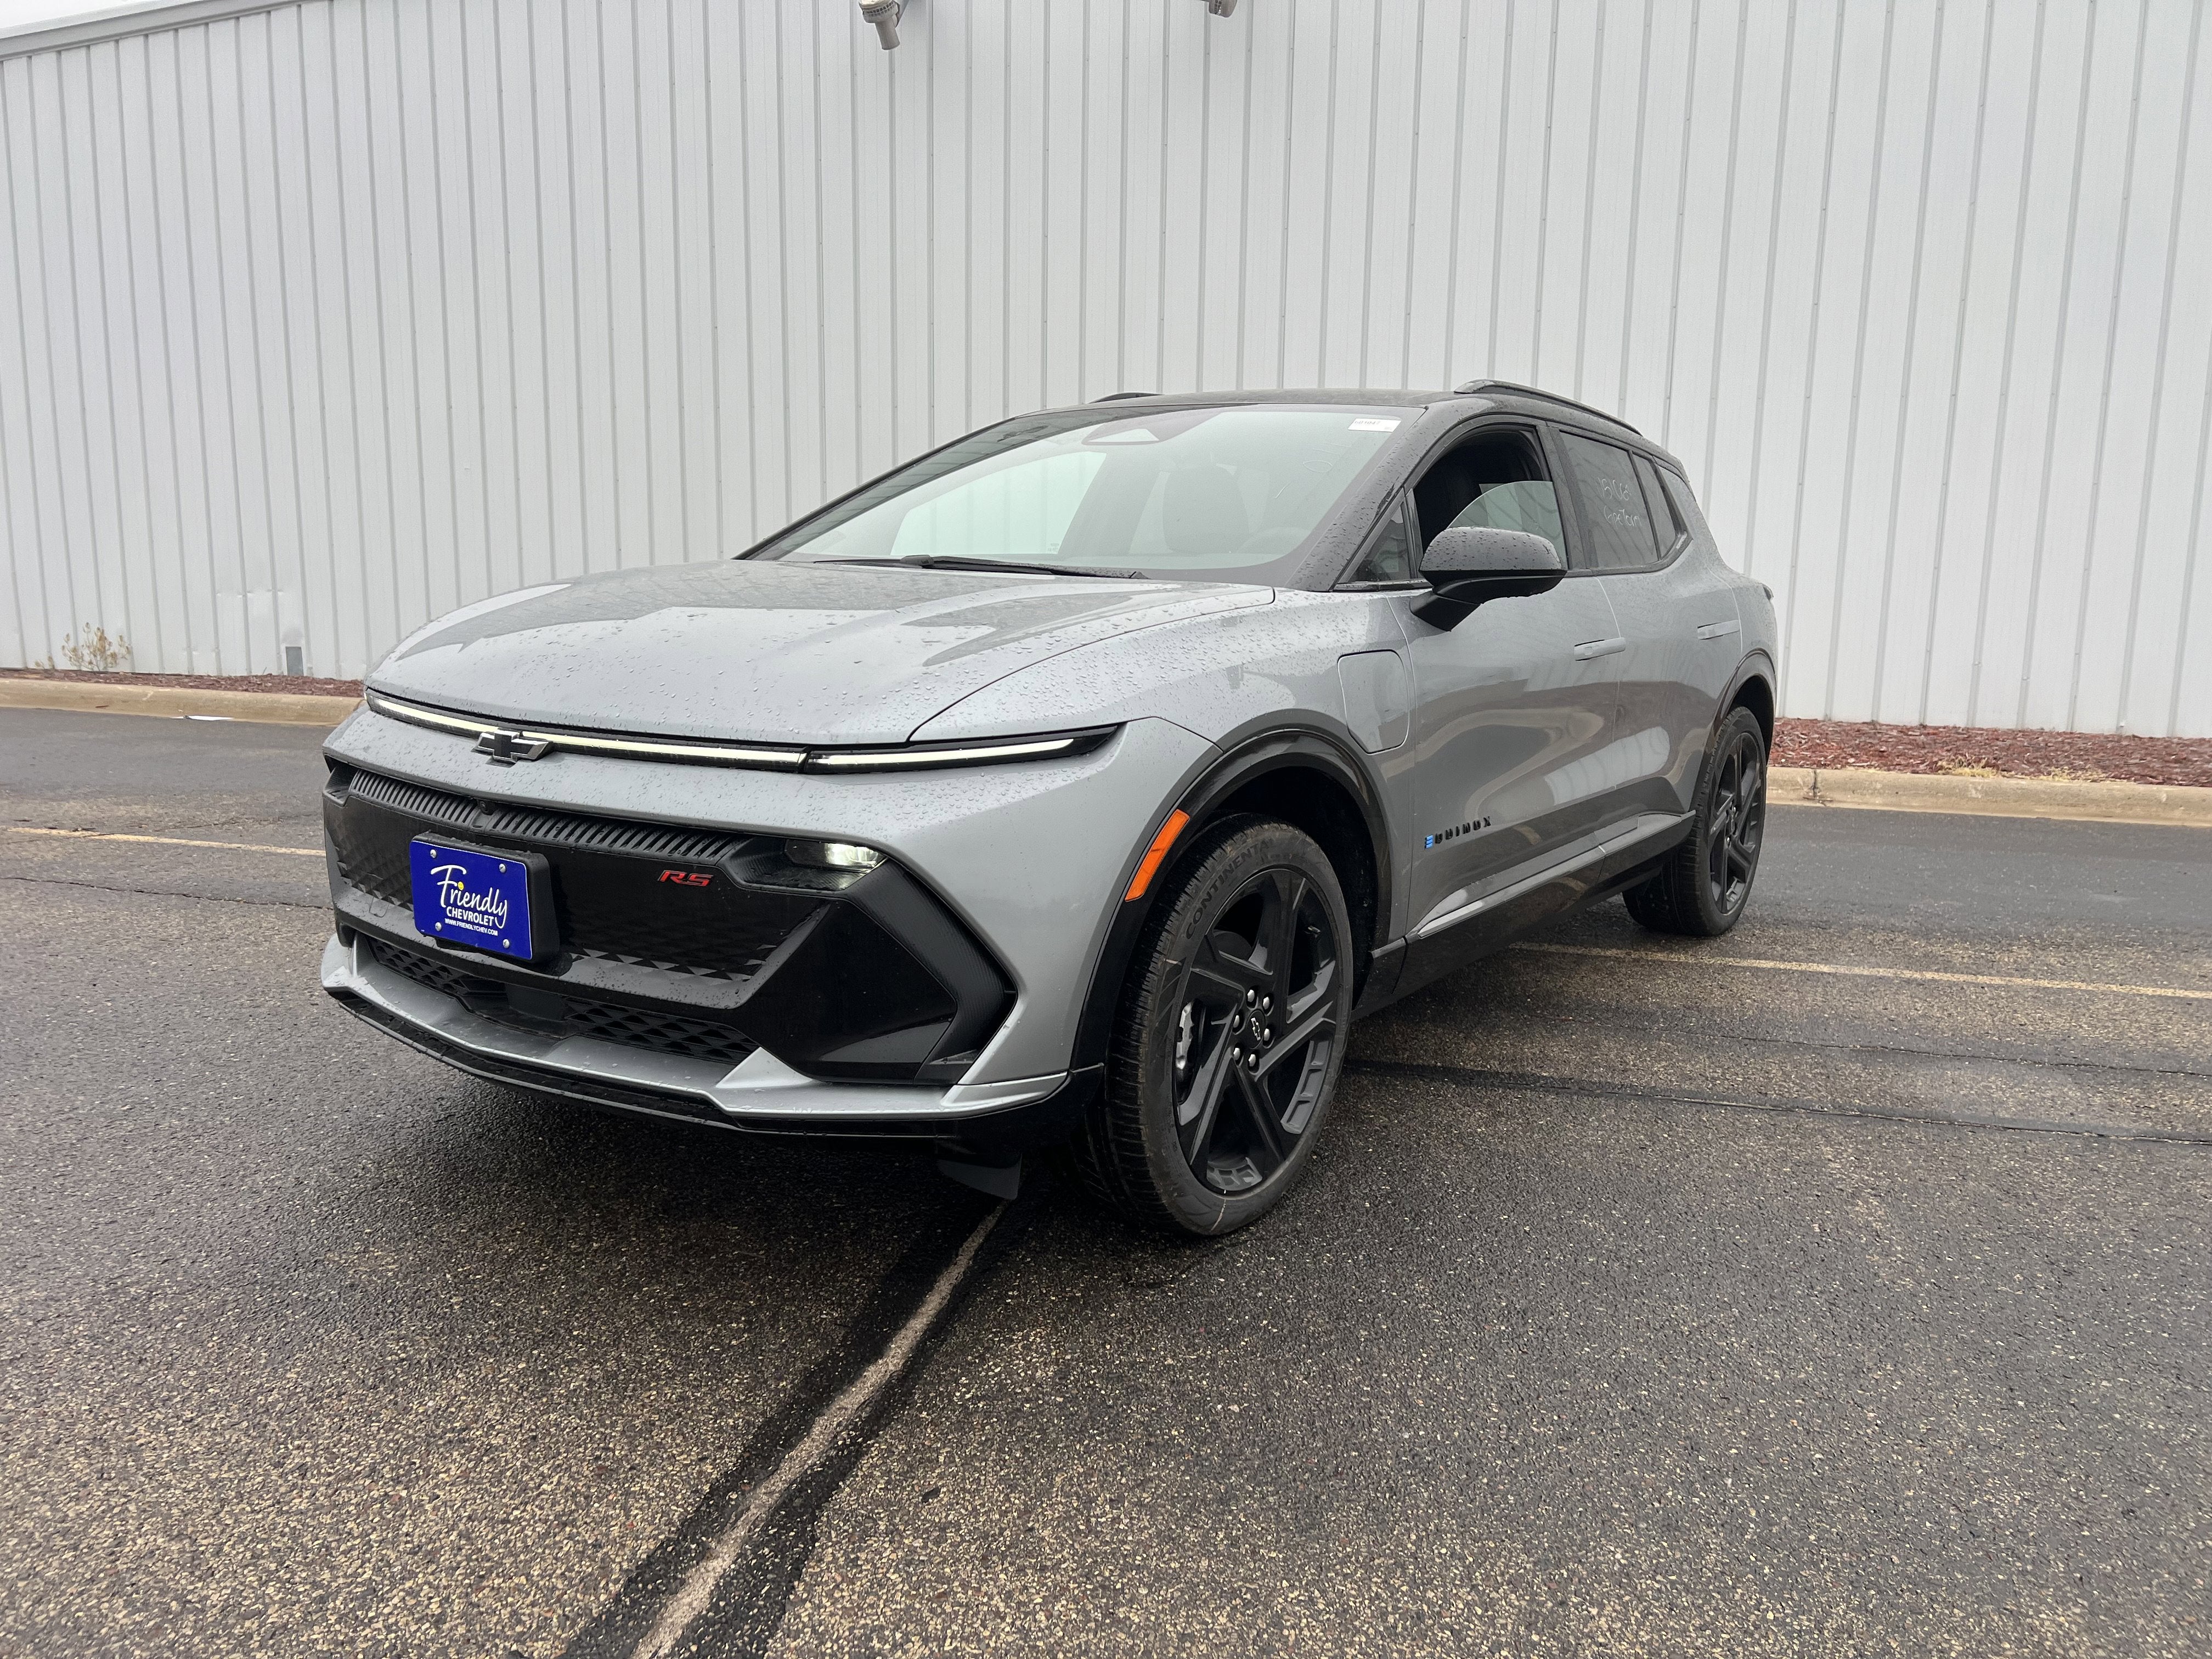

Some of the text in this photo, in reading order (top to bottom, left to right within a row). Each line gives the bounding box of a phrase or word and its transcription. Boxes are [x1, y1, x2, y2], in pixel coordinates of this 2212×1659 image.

[1425, 816, 1491, 850] EQUINOX
[657, 870, 713, 887] RS
[431, 865, 507, 929] Friendly
[444, 918, 498, 936] WWW.FRIENDLYCHEV.COM
[446, 906, 494, 927] CHEVROLET
